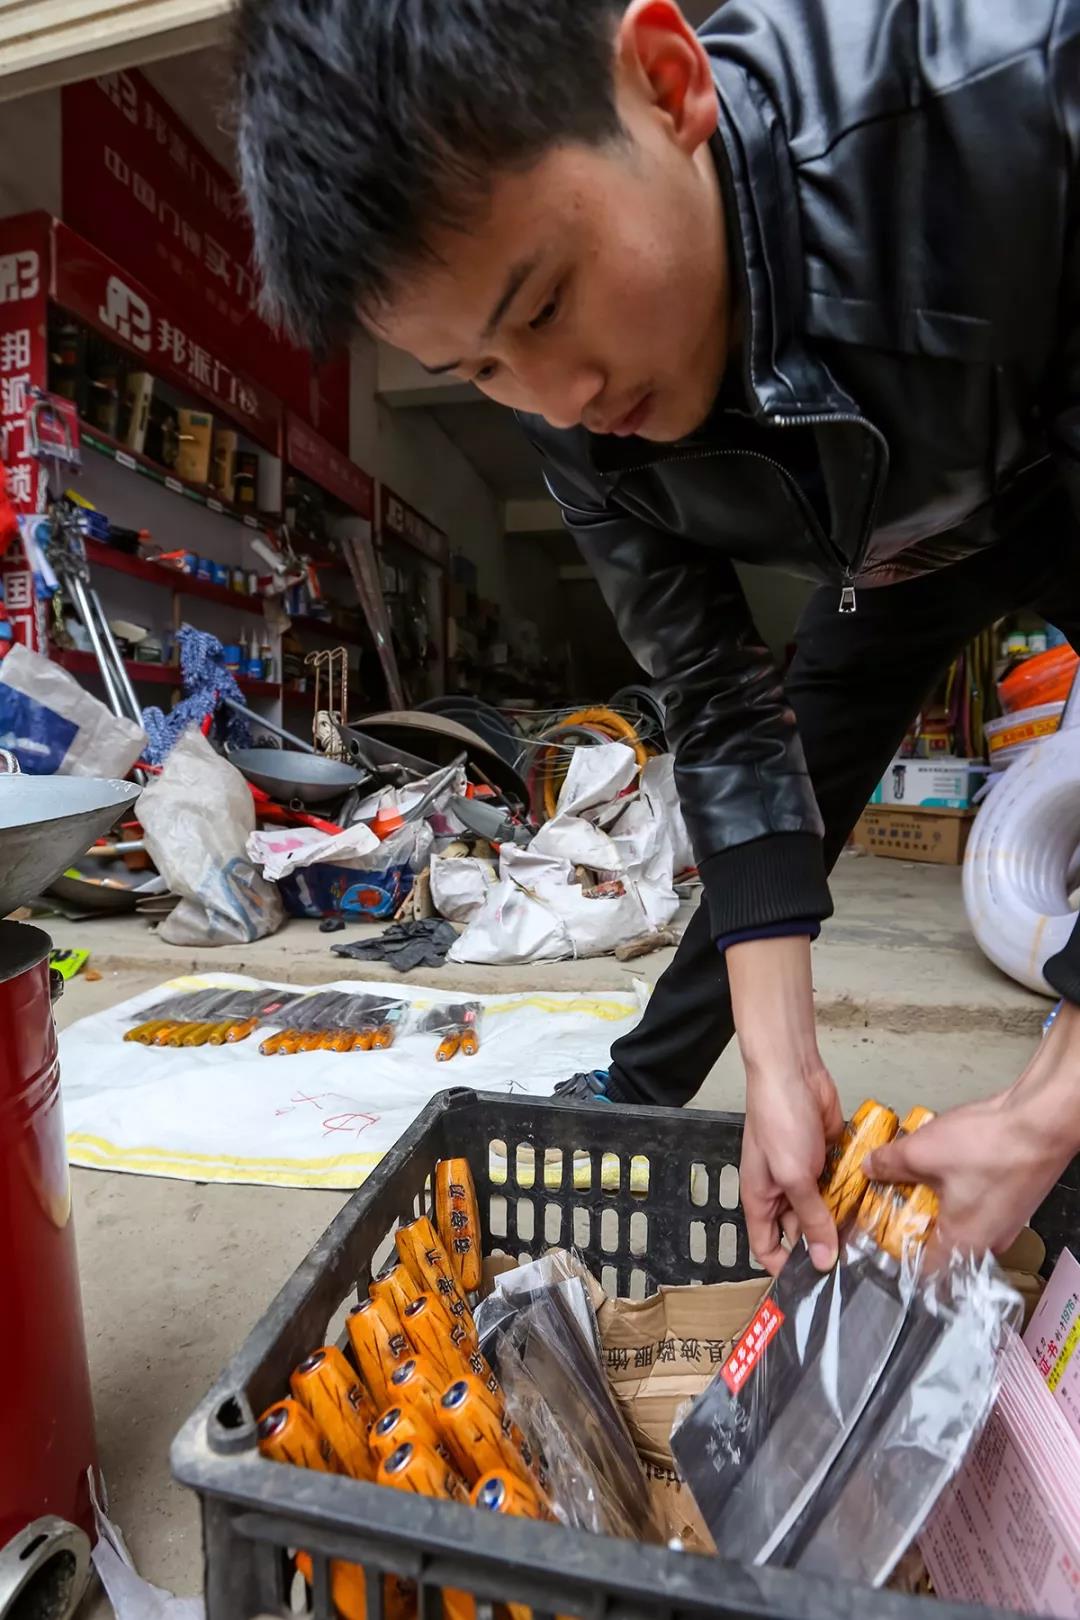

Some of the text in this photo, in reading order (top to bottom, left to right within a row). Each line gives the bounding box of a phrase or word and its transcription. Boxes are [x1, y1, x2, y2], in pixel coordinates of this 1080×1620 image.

[1, 329, 31, 504] 邦派门锁
[607, 1336, 741, 1372] 县波路服饰
